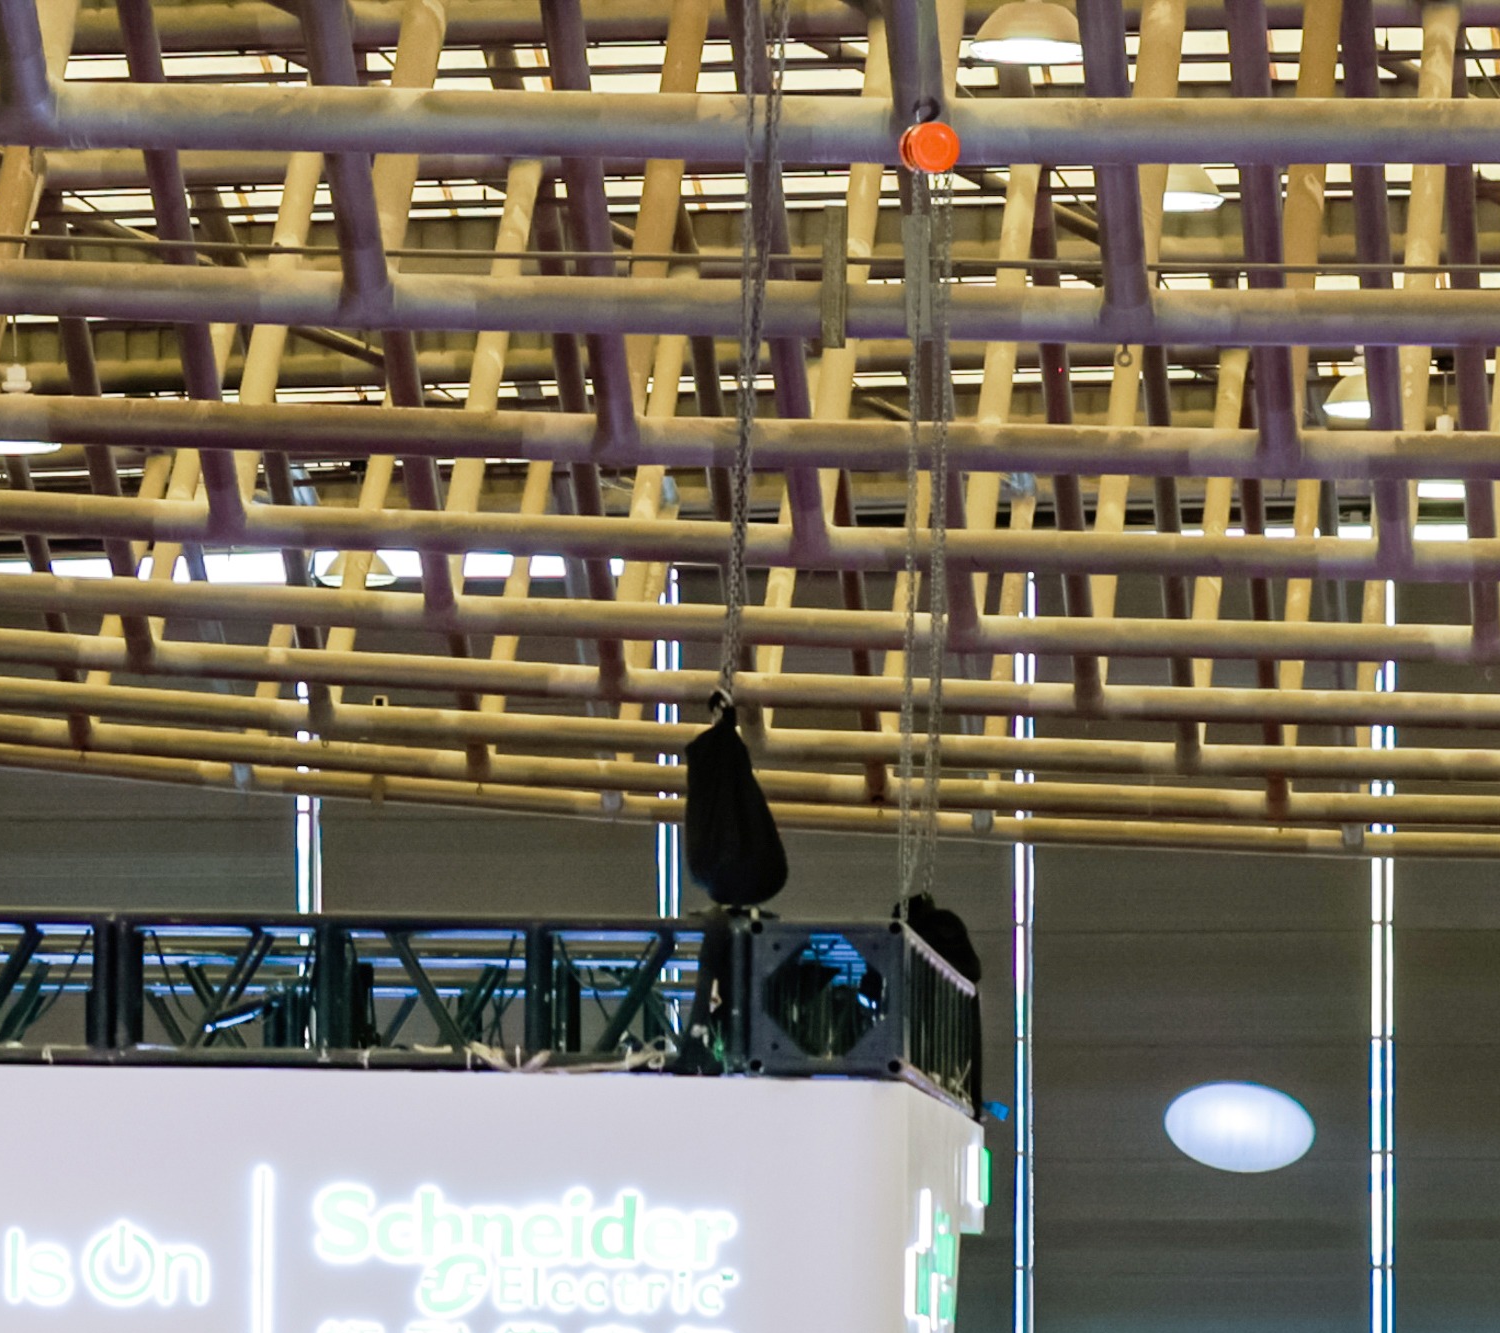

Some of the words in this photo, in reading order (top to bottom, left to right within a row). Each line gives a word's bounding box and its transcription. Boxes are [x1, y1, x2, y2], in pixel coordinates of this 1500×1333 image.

[316, 1184, 737, 1265] Schneider
[4, 1226, 73, 1303] Is
[498, 1268, 730, 1312] Electric
